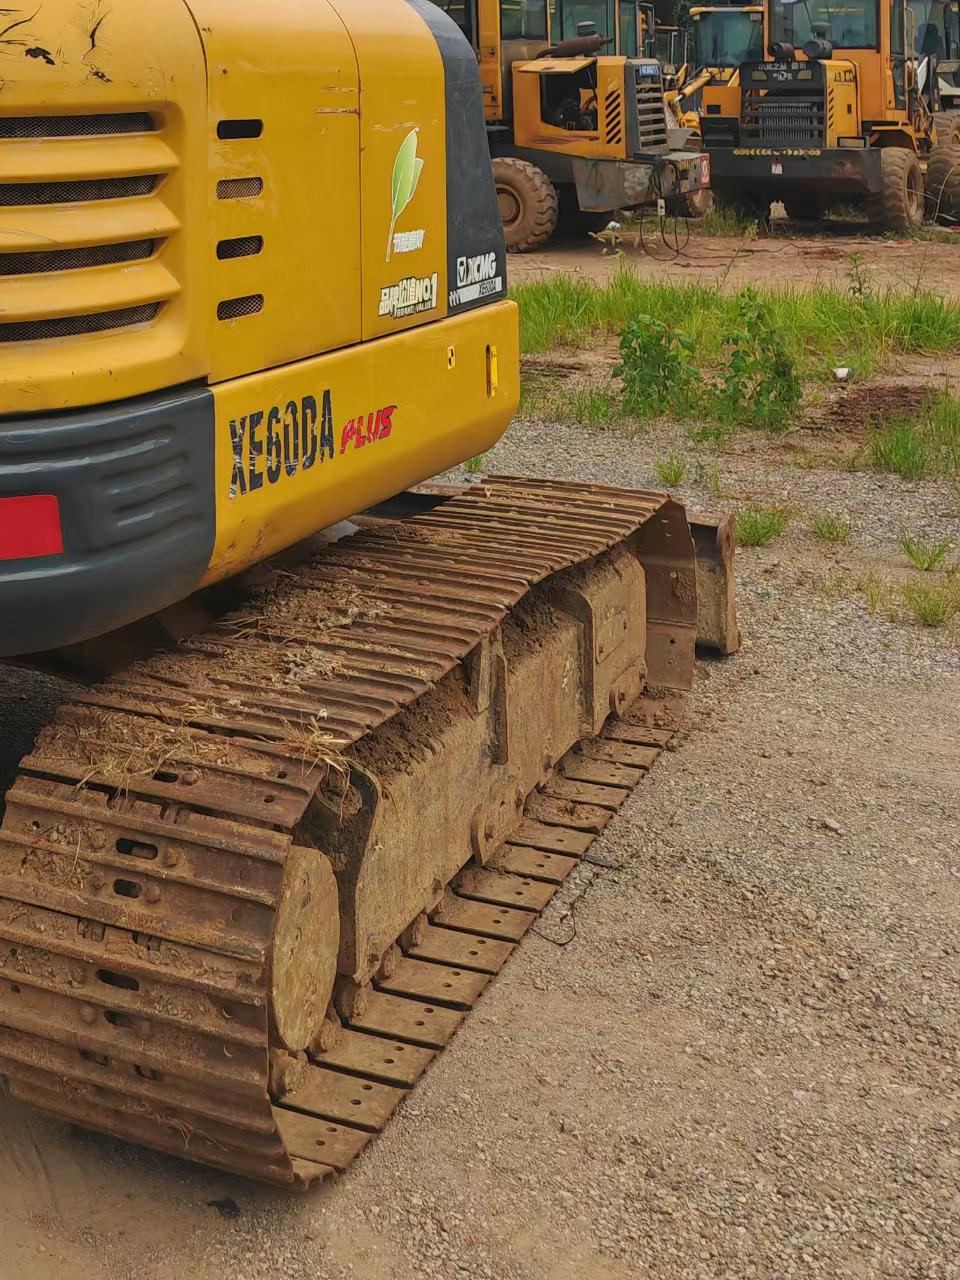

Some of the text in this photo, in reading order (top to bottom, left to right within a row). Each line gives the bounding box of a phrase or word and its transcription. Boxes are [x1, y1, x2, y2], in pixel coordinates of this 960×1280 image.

[466, 251, 497, 285] XCMG
[228, 388, 398, 500] XE60DA PLUS
